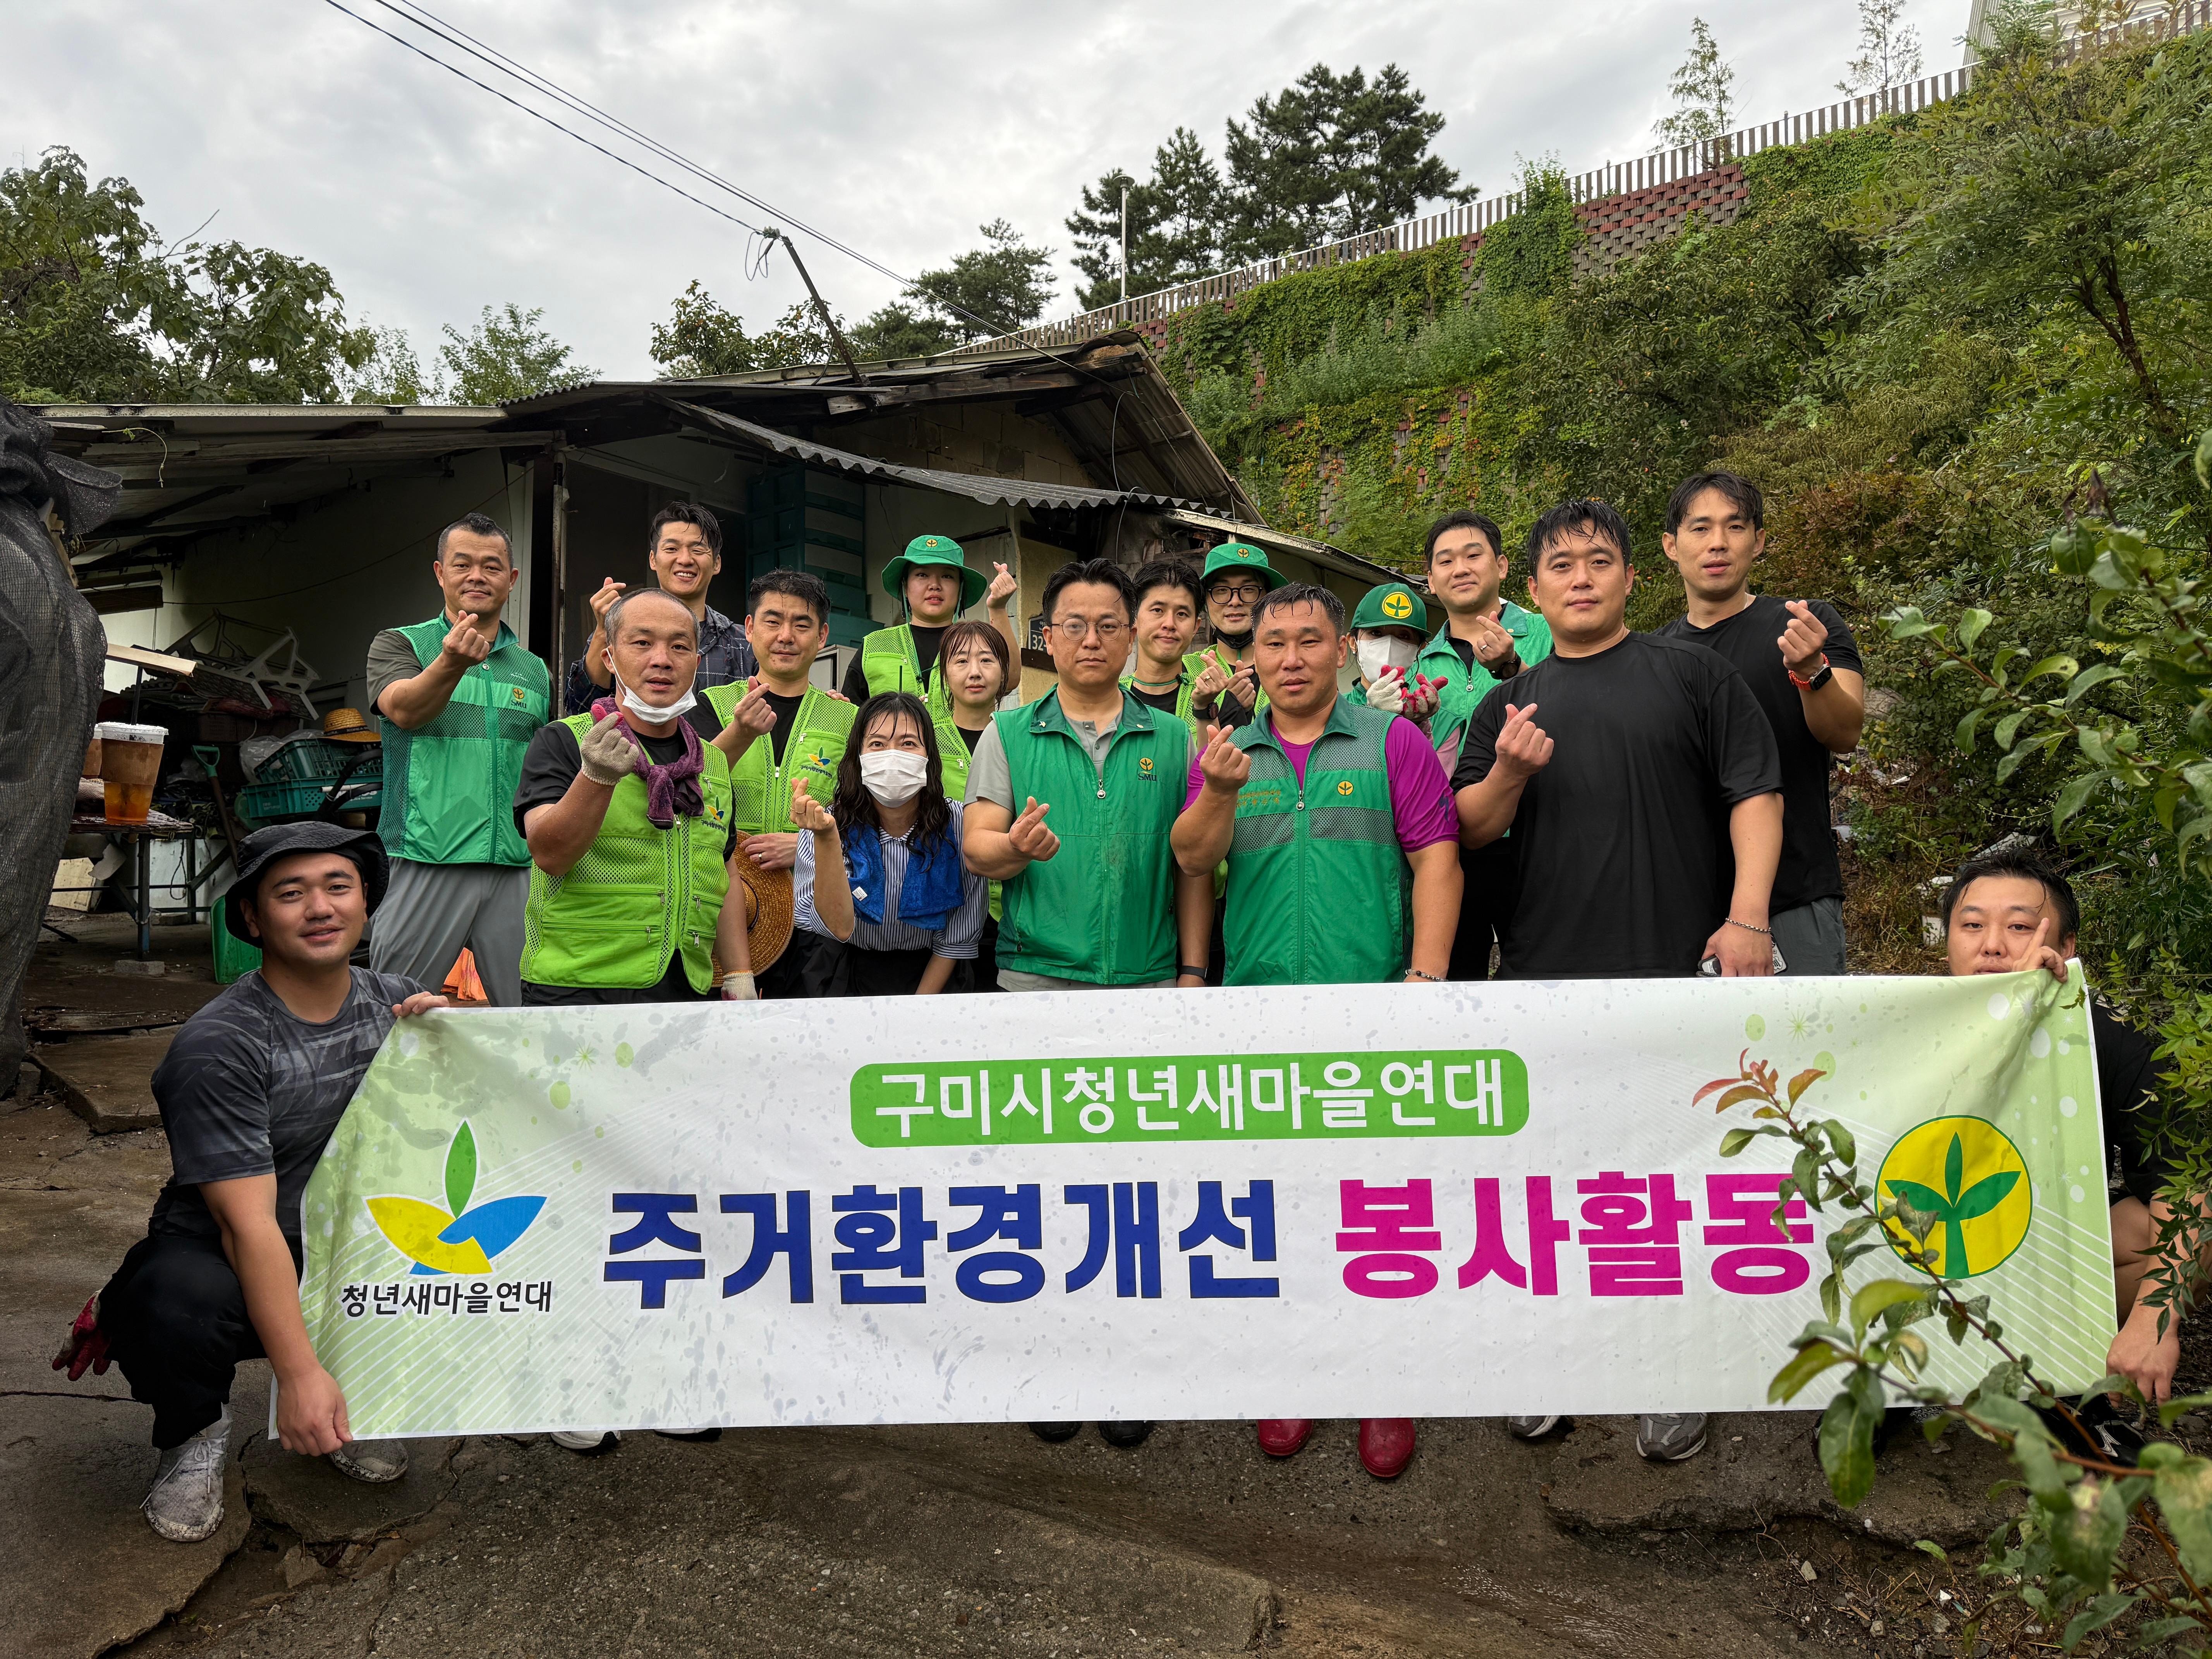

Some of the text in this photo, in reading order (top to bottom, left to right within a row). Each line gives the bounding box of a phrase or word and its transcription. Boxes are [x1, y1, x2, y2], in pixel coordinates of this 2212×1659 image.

[511, 699, 527, 709] SMU
[1138, 772, 1157, 781] SMU
[876, 1059, 1503, 1138] 구미시청년새마을연대
[604, 1171, 1814, 1309] 주거환경개선 봉사활동
[342, 1281, 551, 1317] 청년새마을연대
